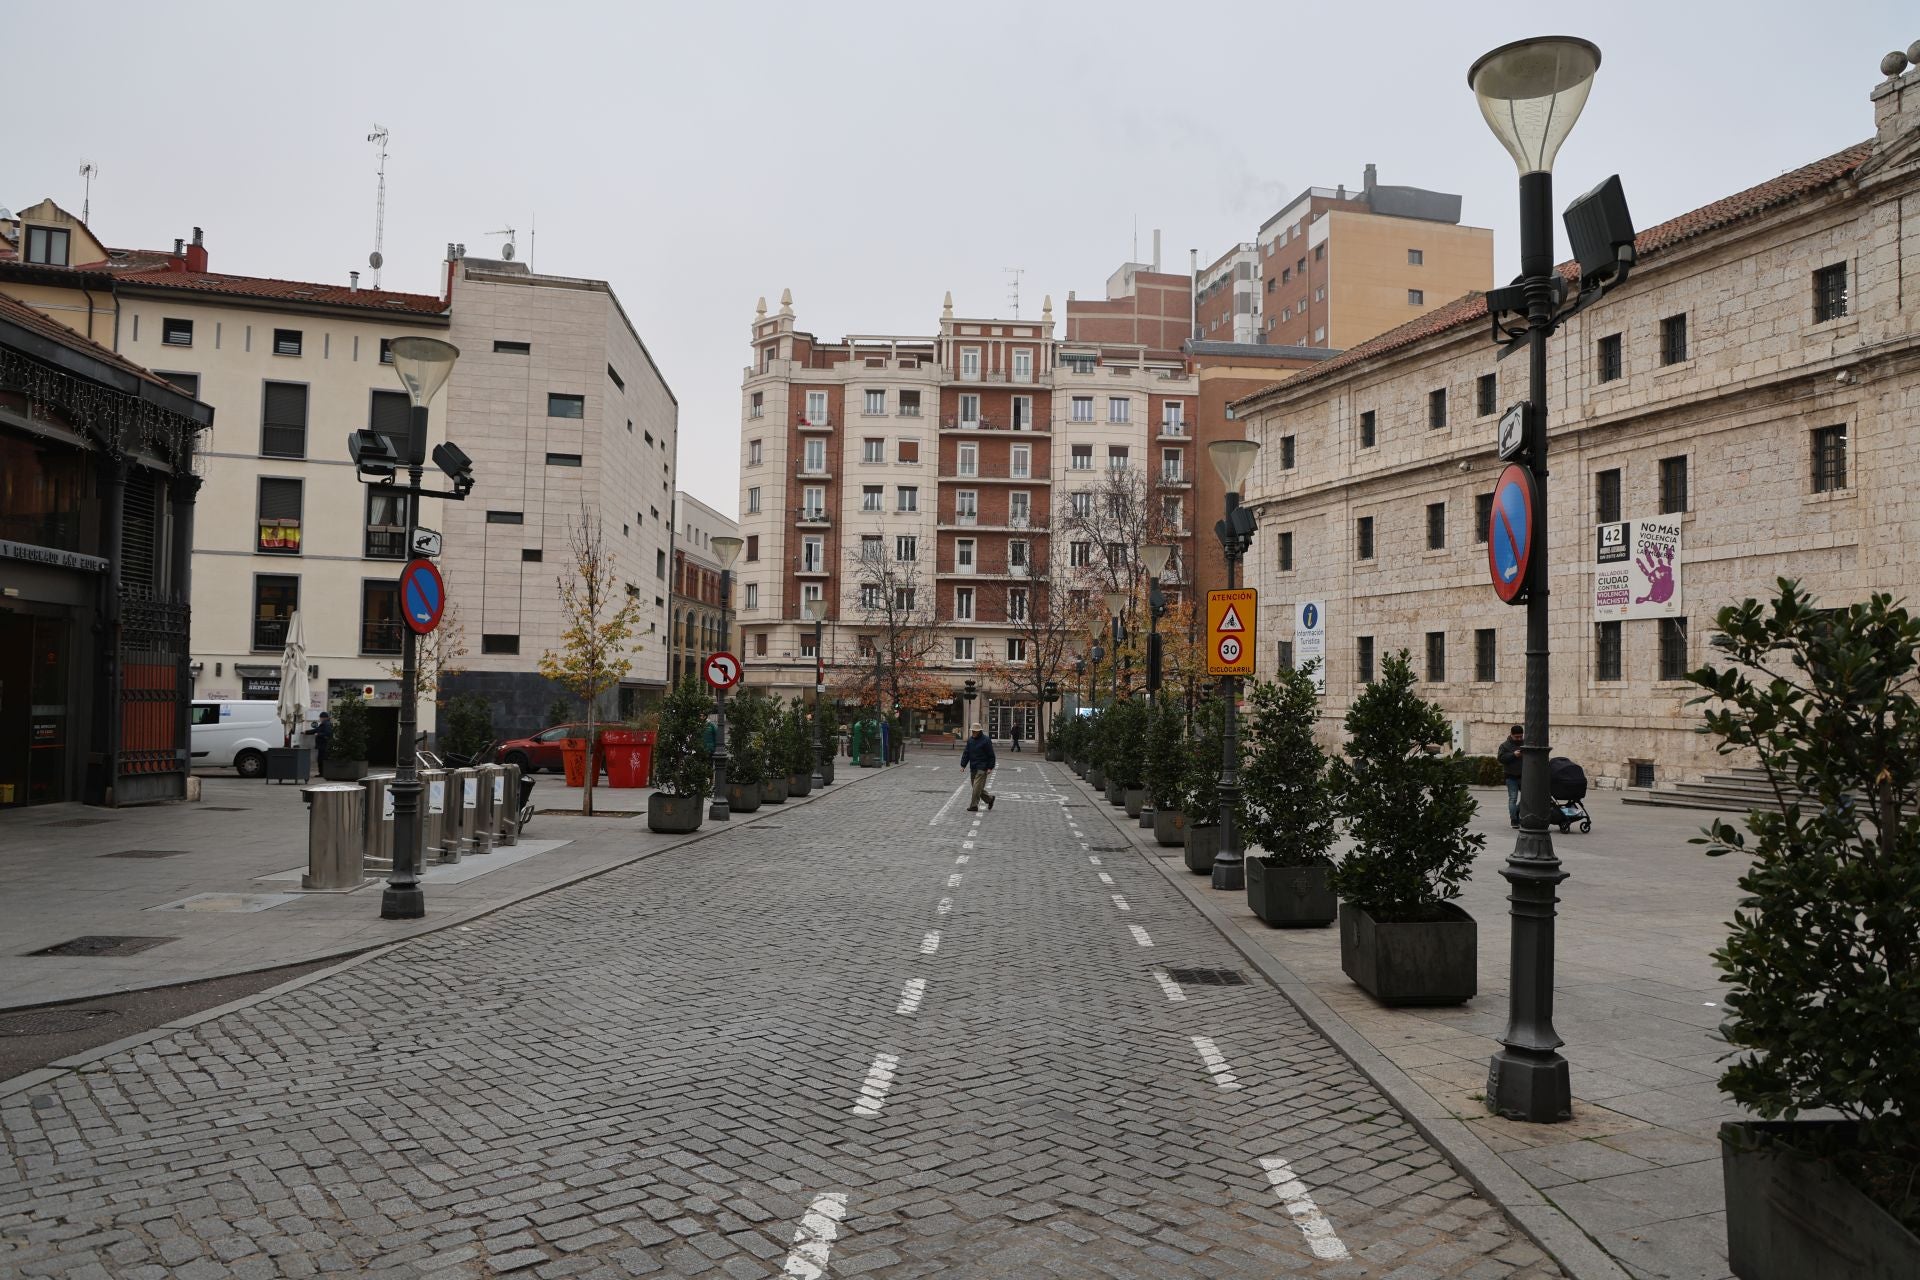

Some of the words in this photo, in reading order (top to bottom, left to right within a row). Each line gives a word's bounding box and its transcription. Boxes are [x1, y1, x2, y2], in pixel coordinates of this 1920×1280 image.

[1641, 522, 1656, 532] NO
[1658, 524, 1680, 536] MÁS
[1605, 529, 1620, 542] 42
[1640, 532, 1677, 543] VIOLENCIA
[1638, 540, 1675, 552] CONTRA
[1598, 576, 1628, 585] CIUDAD
[1212, 592, 1252, 601] ATENCIÓN
[1598, 590, 1629, 598] VIOLENCIA
[1597, 597, 1629, 605] MACHISTA
[1297, 629, 1324, 637] Información
[1223, 645, 1237, 655] 30
